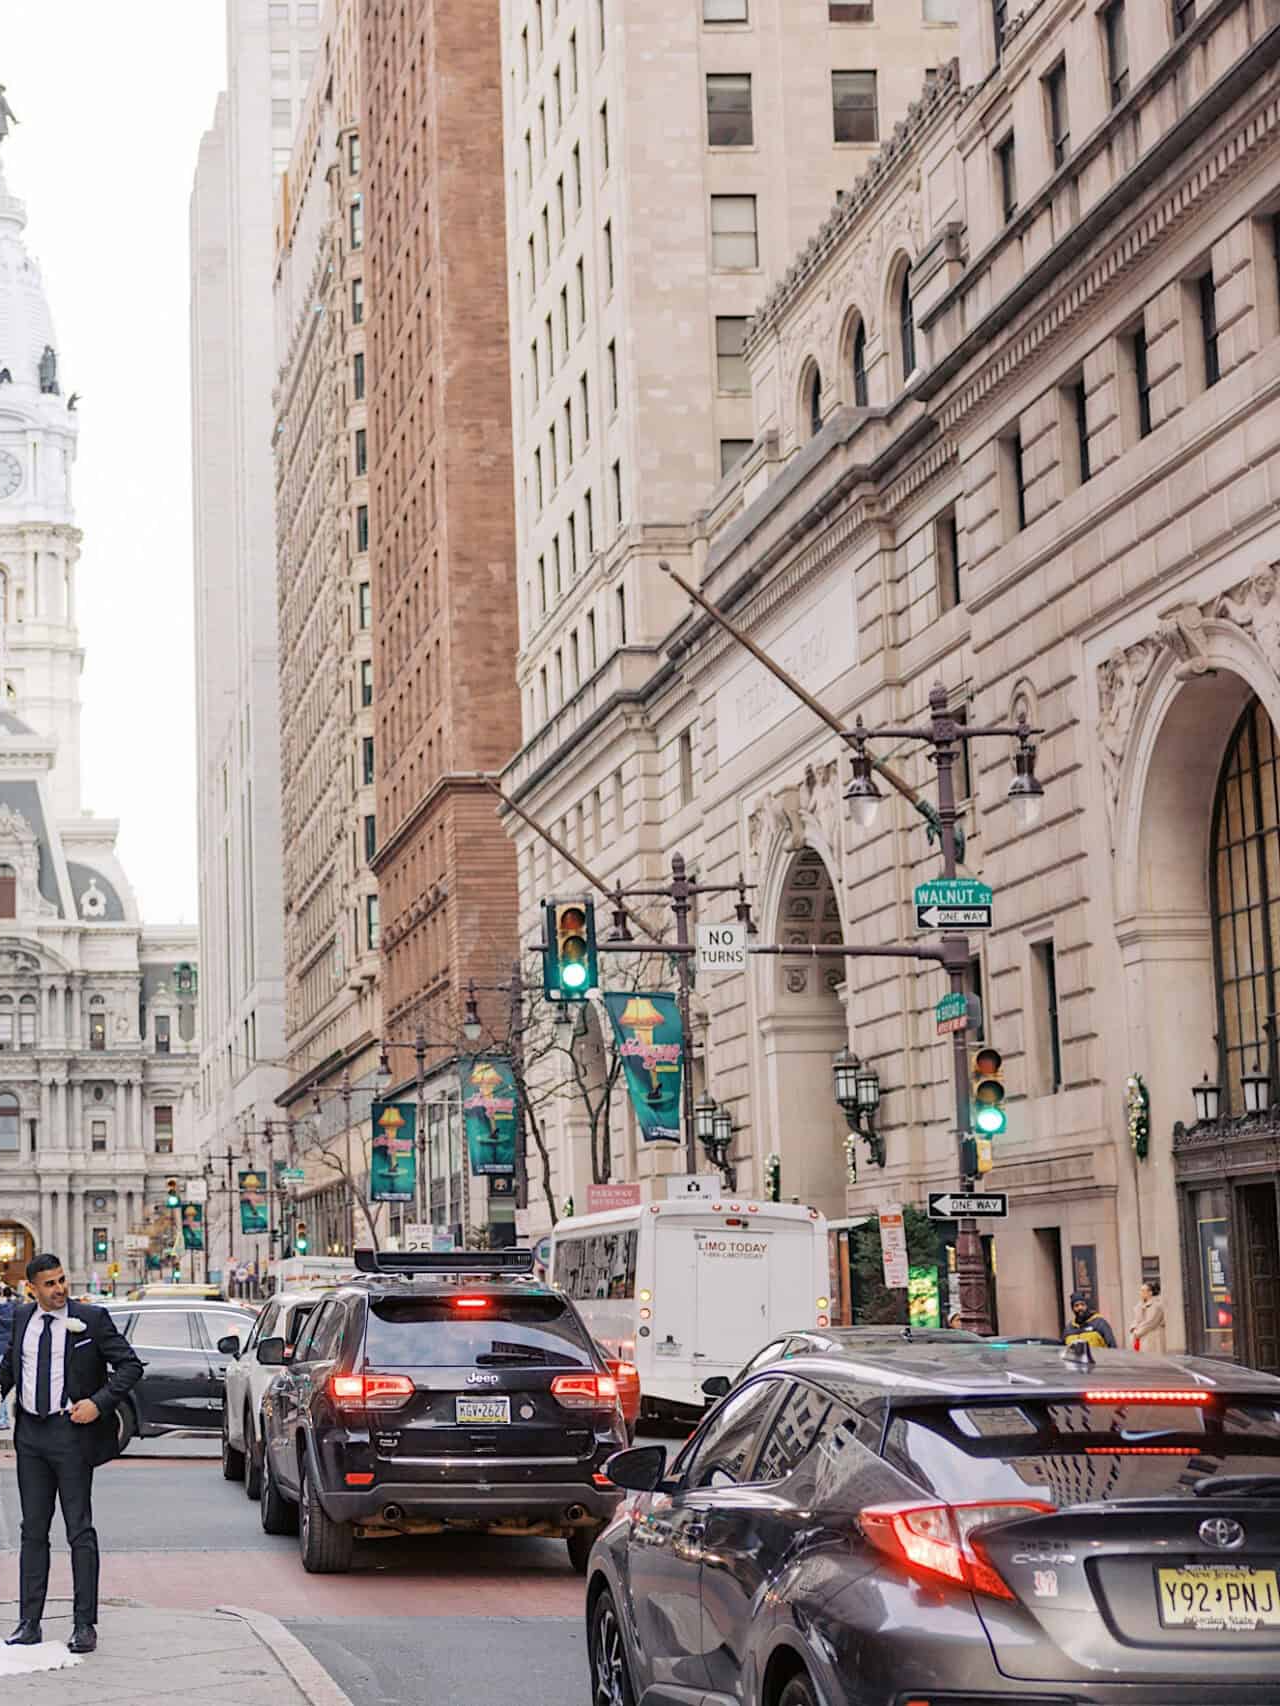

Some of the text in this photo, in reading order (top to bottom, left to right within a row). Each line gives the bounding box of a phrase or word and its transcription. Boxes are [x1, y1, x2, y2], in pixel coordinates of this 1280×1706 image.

[918, 889, 991, 903] WALNUT ST
[939, 912, 984, 921] ONE WAY
[709, 930, 734, 945] NO
[702, 951, 743, 962] TURNS
[952, 1200, 998, 1209] ONE WAY
[698, 1242, 768, 1253] LIMO TODAY
[466, 1372, 499, 1385] Jeep
[1165, 1582, 1274, 1613] Y92 PNJ
